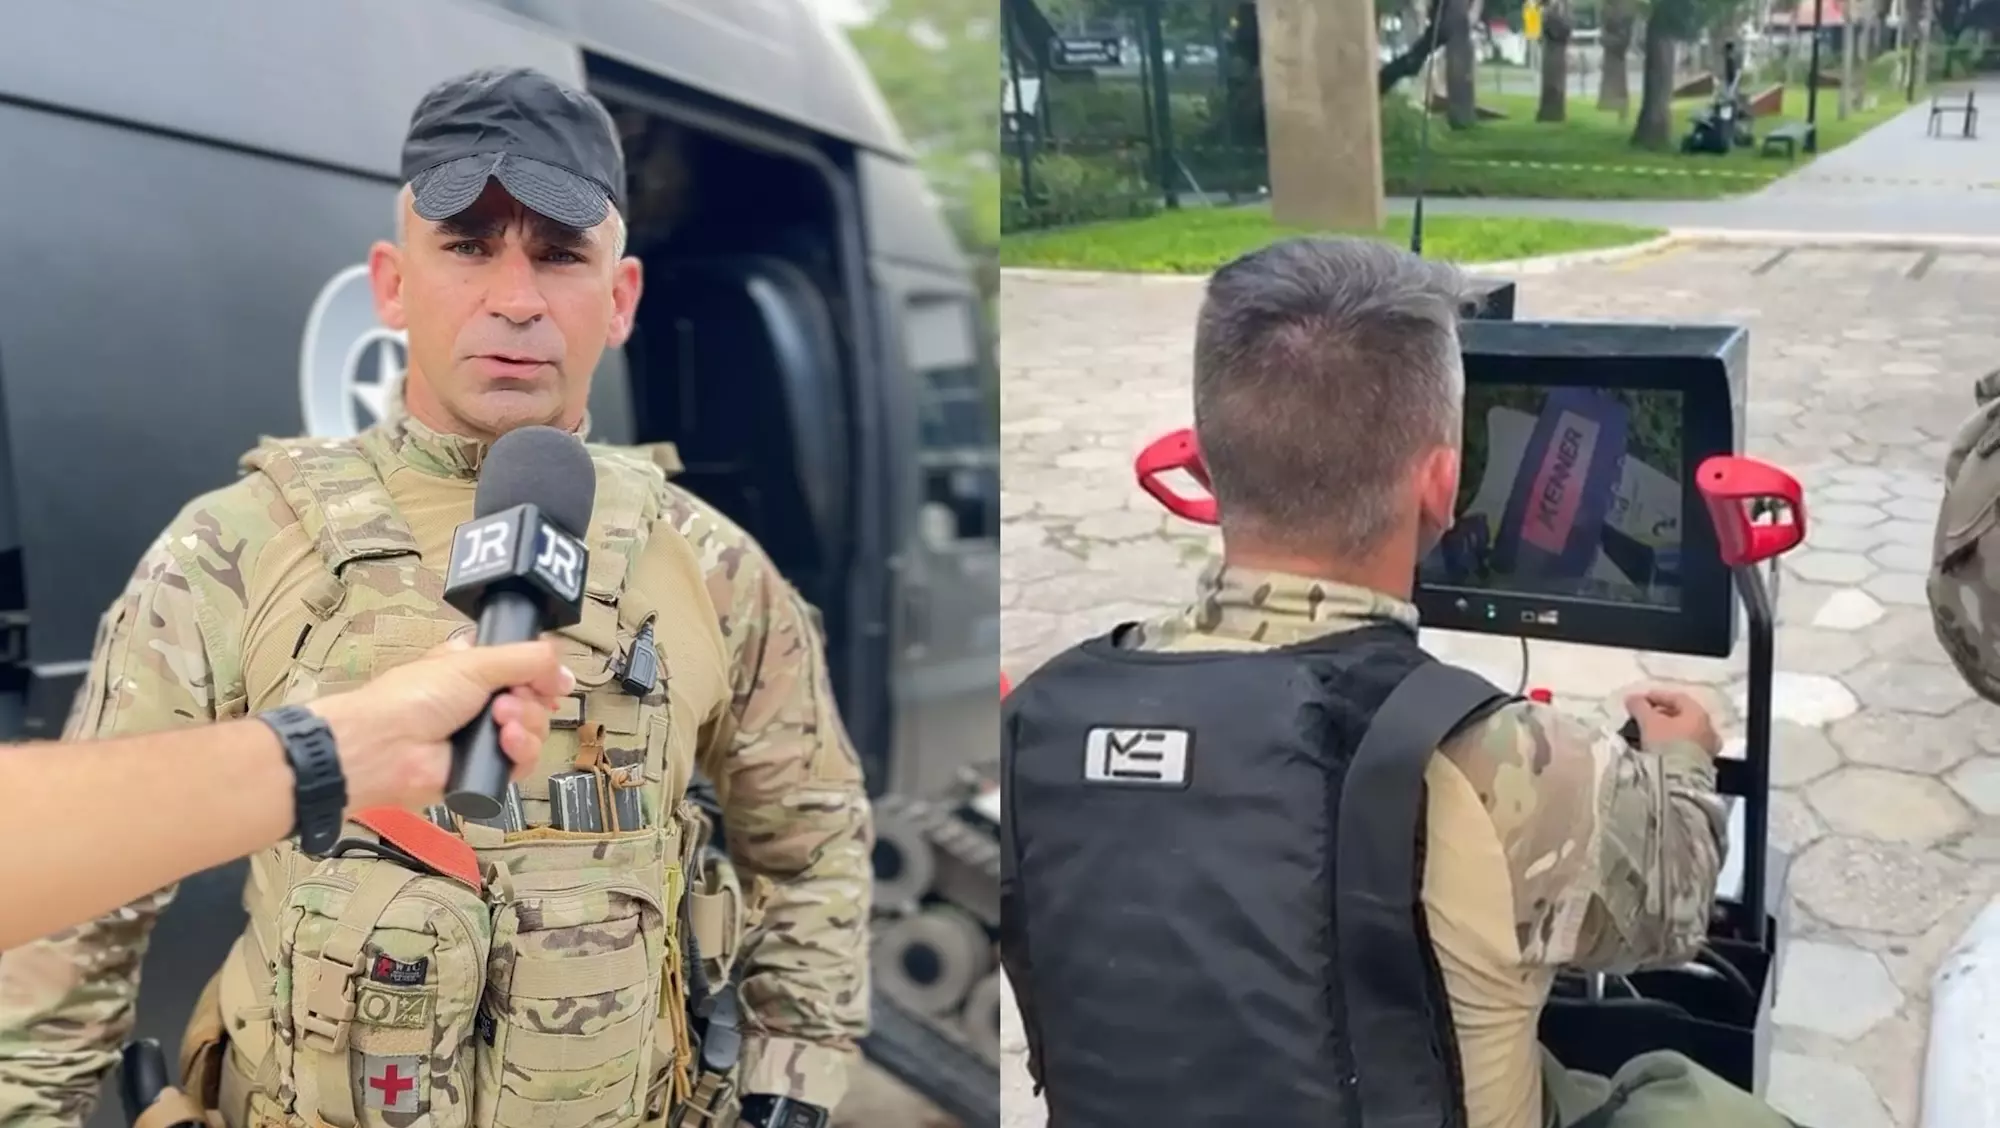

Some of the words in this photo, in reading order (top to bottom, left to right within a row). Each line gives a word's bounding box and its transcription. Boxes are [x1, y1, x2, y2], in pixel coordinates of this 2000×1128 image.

[1536, 427, 1583, 532] KENNER
[461, 521, 509, 569] JR
[537, 524, 578, 588] JR
[395, 962, 421, 971] WTC
